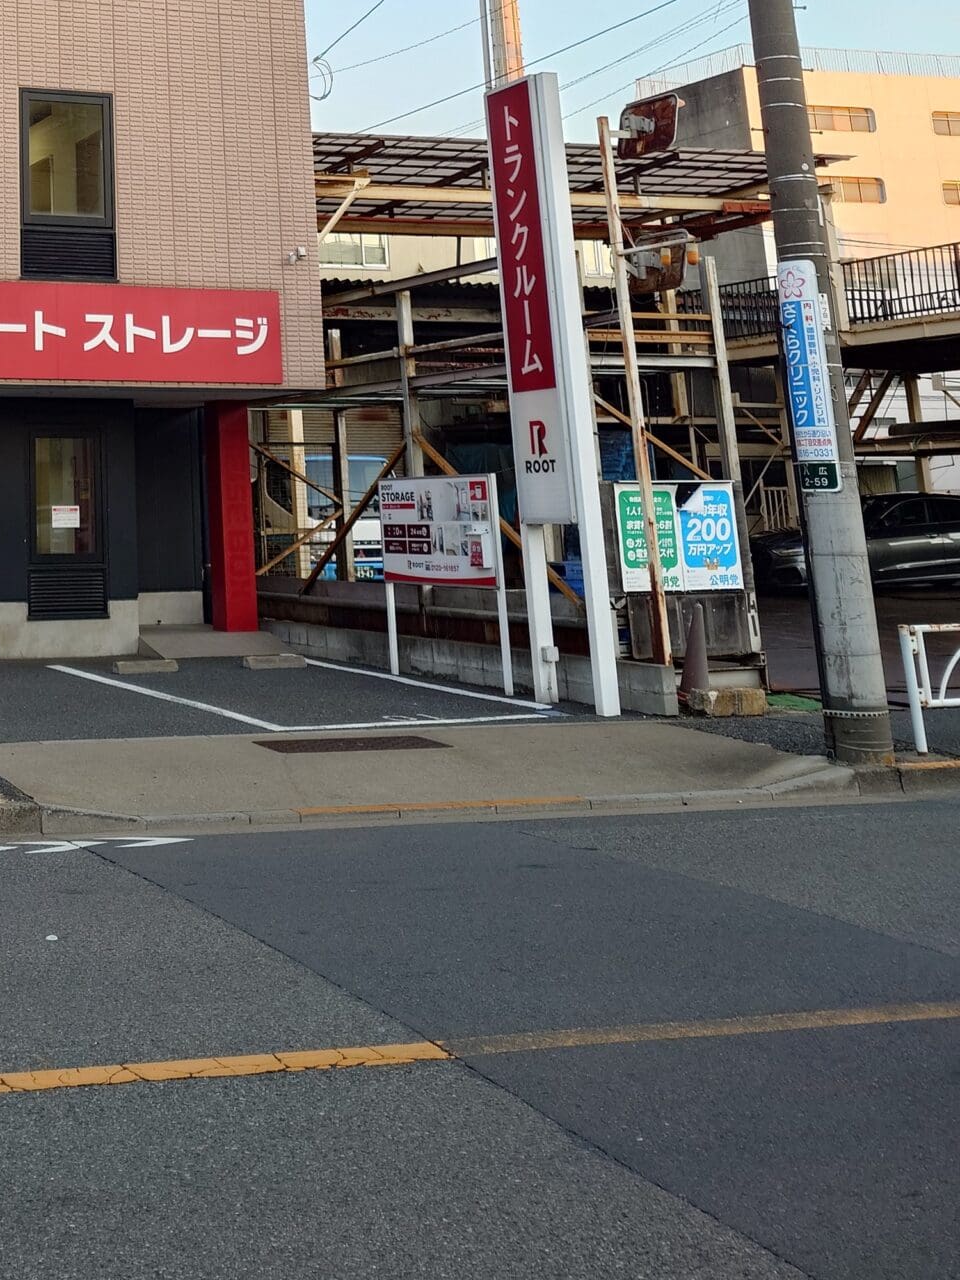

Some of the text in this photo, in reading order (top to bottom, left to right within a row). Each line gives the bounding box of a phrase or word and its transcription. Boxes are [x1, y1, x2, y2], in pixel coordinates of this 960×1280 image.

[503, 105, 544, 375] トランクルーム
[83, 313, 269, 355] ストレージ
[782, 303, 809, 426] さくらクリニック
[525, 459, 556, 475] ROOT
[804, 477, 829, 487] 2-59
[381, 491, 416, 502] STORAGE
[686, 517, 731, 542] 200
[687, 542, 733, 556] 万円アップ
[709, 573, 740, 586] 公明党
